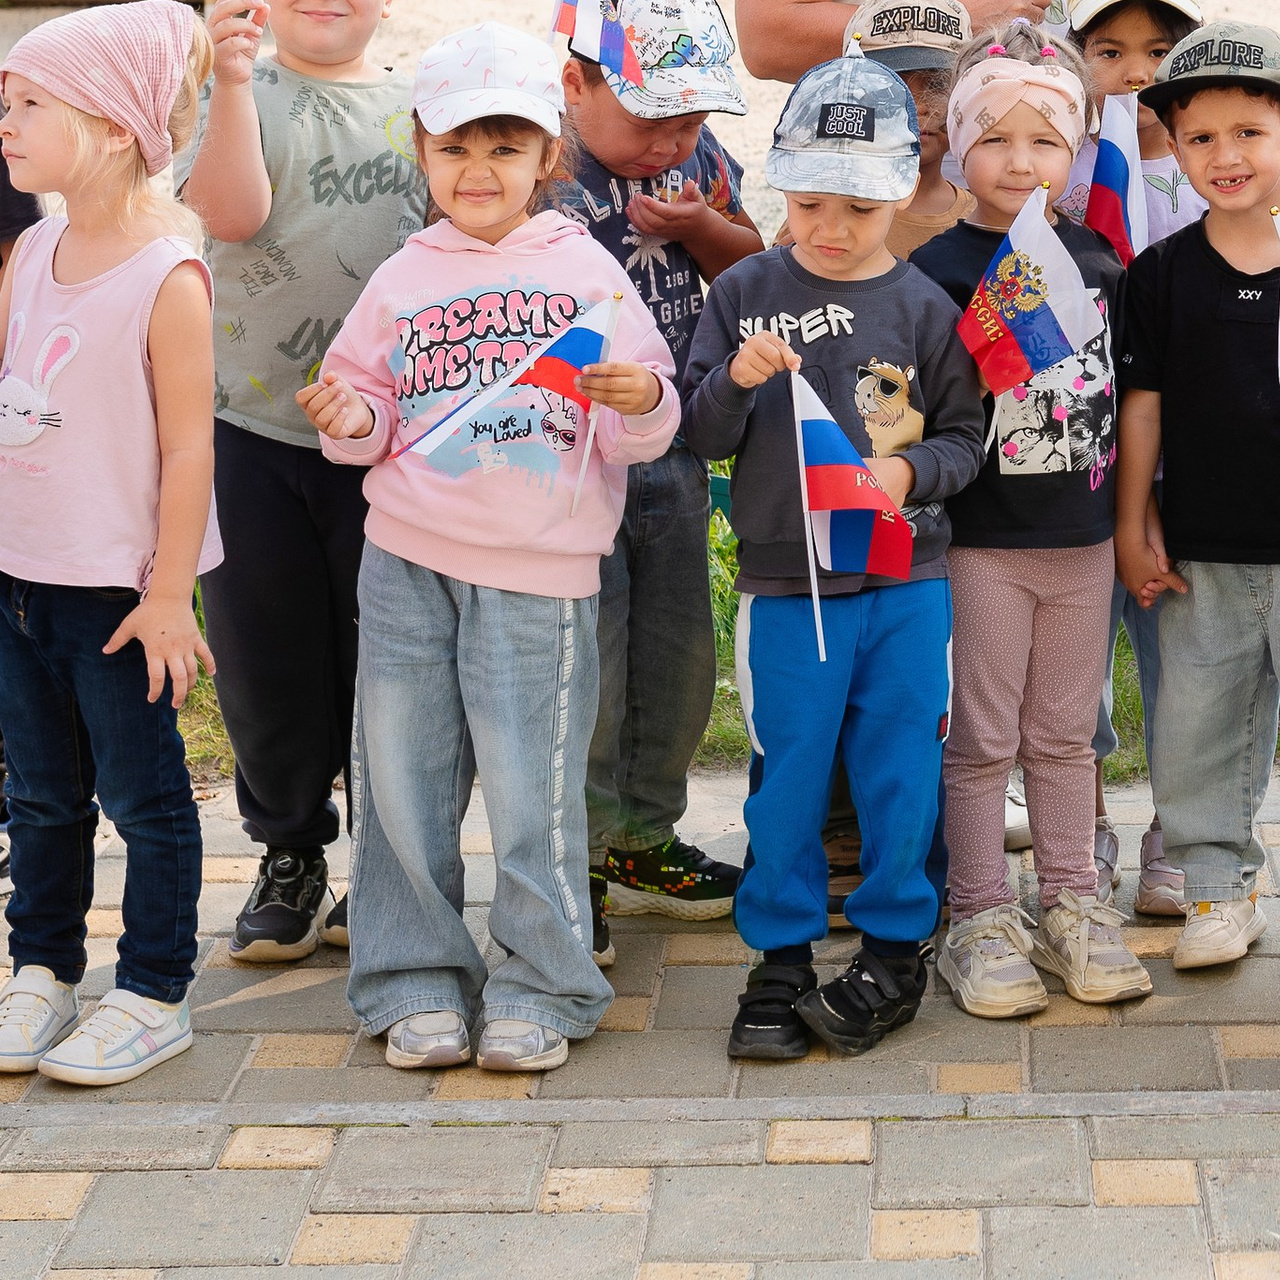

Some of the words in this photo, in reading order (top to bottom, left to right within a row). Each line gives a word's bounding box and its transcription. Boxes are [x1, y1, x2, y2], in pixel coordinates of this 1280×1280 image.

[871, 6, 963, 41] EXPLORE
[1169, 39, 1264, 80] EXPLORE
[829, 105, 867, 122] JUST
[825, 120, 866, 137] COOL
[254, 238, 302, 282] MOMENT
[250, 260, 280, 287] EACH
[1238, 289, 1263, 300] XXY
[650, 293, 702, 324] GELE
[469, 420, 492, 438] You
[498, 415, 517, 429] are
[493, 418, 532, 443] Loved
